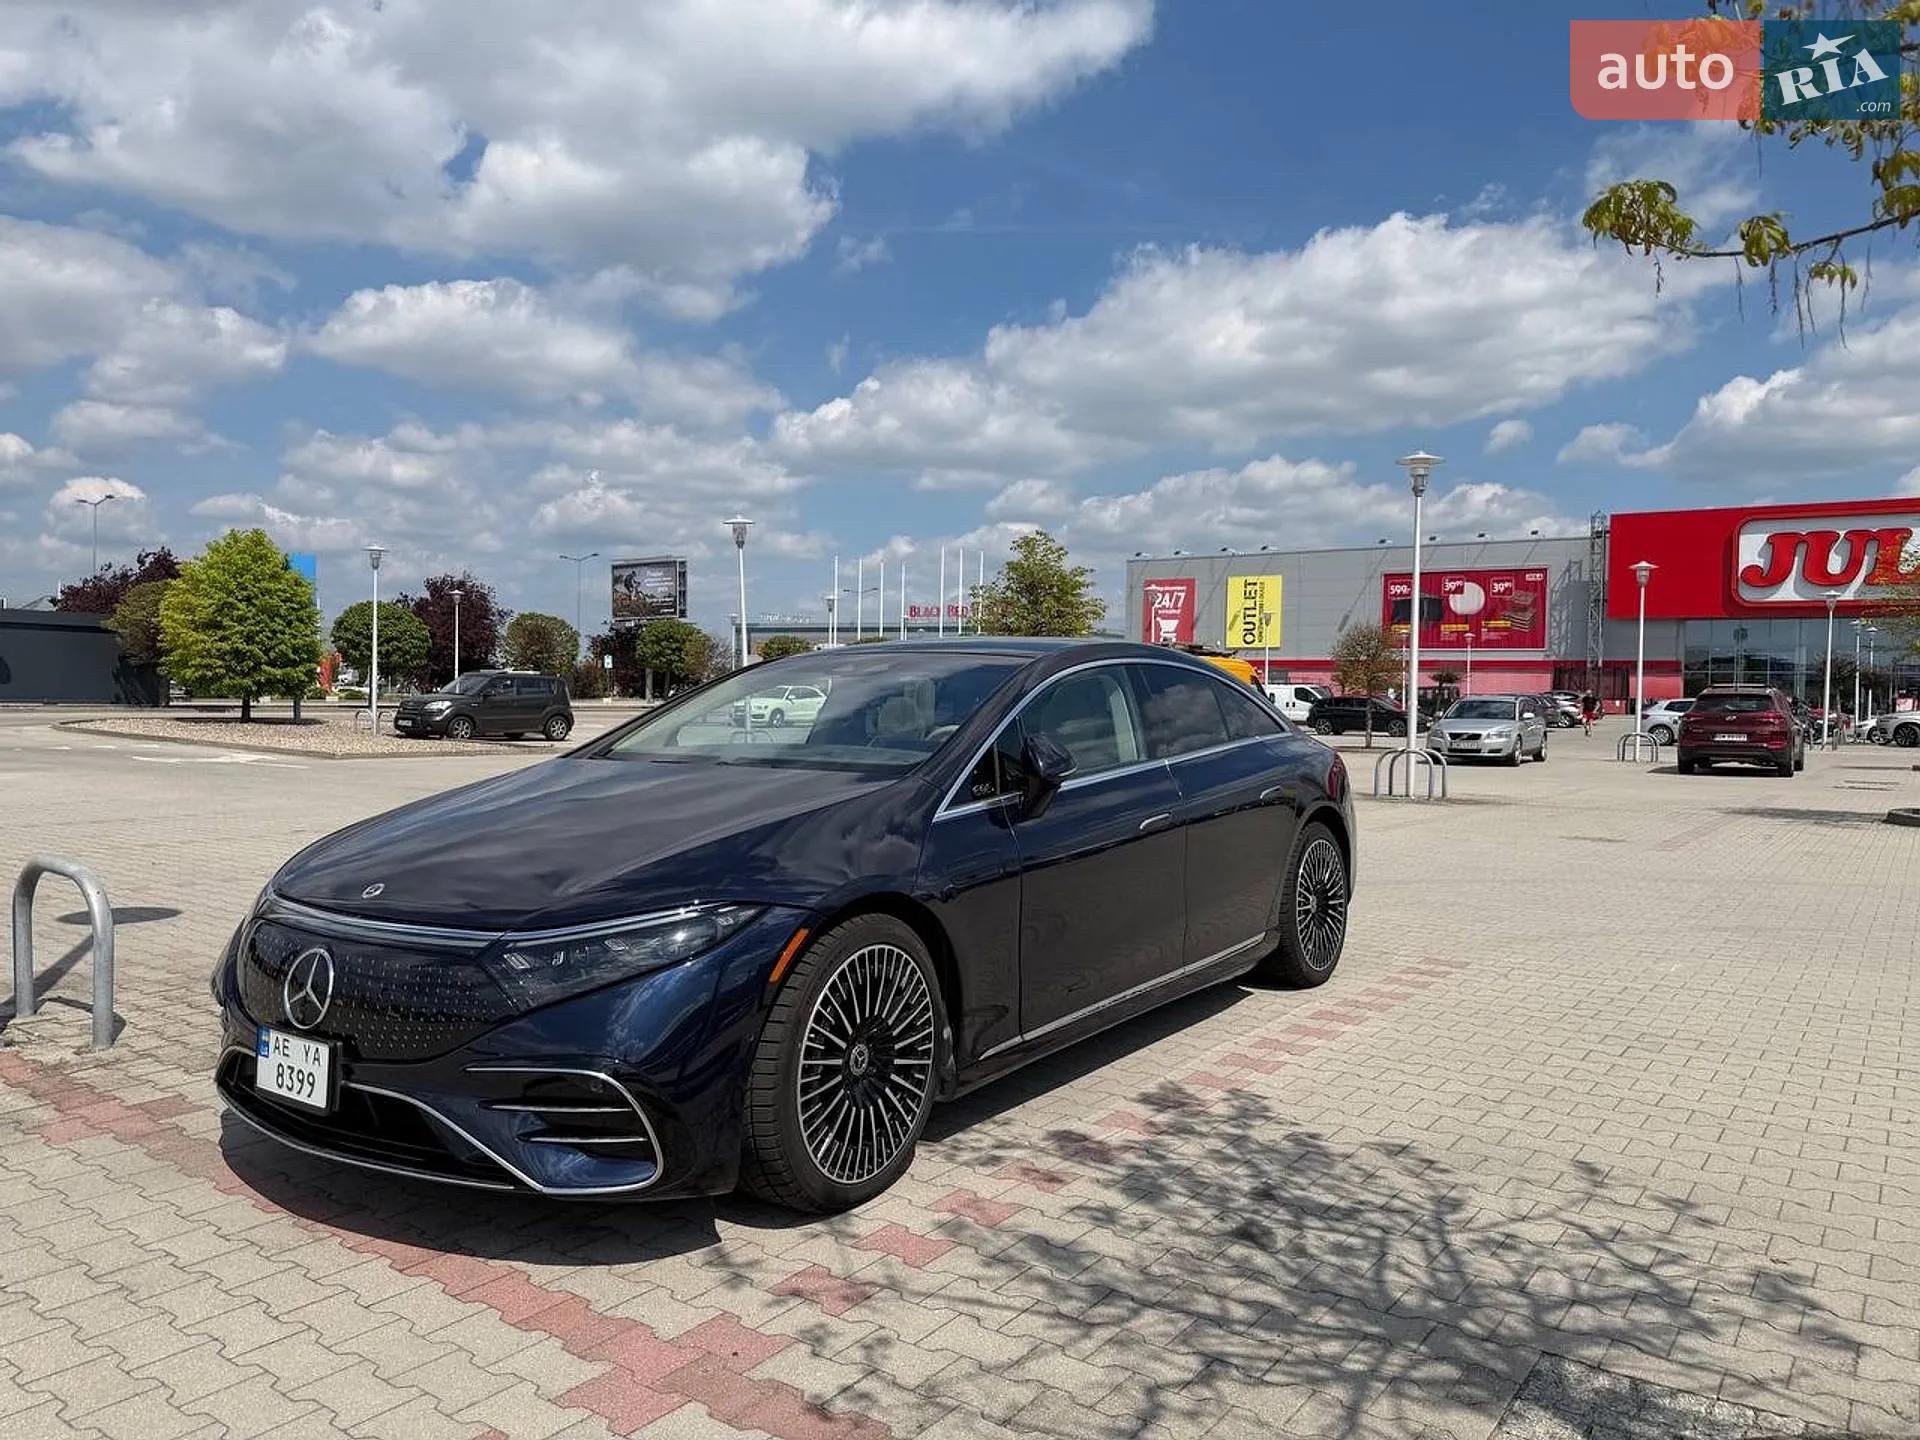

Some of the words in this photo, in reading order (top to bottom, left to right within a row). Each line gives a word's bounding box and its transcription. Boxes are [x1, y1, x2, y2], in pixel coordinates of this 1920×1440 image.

[1154, 592, 1186, 609] 24/7
[1243, 579, 1257, 645] OUTLET
[273, 1036, 290, 1057] AE
[303, 1044, 321, 1067] YA
[276, 1062, 315, 1098] 8399
